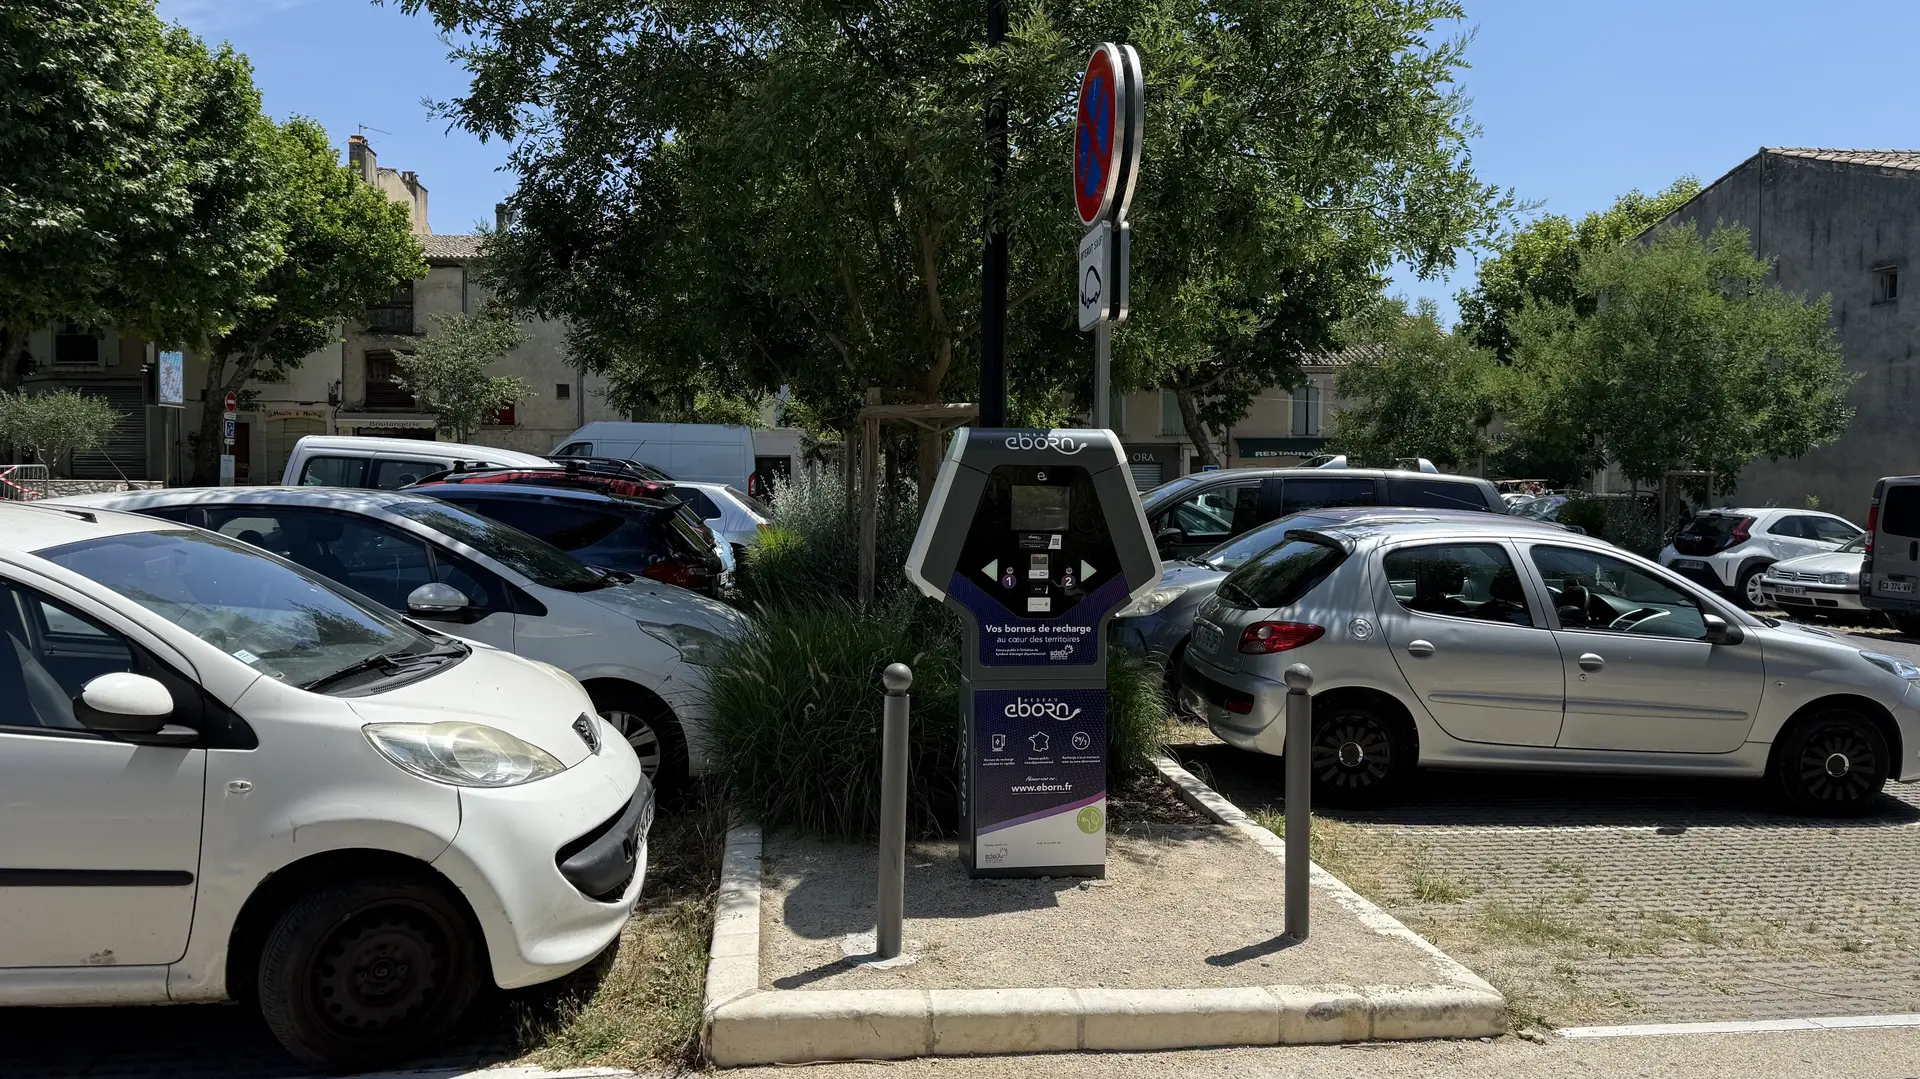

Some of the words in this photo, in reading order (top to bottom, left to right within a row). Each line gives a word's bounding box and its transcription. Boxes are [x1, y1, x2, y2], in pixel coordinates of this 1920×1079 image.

[1005, 432, 1088, 455] eborn
[1132, 452, 1155, 462] ORA
[1005, 576, 1013, 586] 1
[1064, 576, 1073, 586] 2
[985, 624, 1002, 633] Vos
[1005, 624, 1036, 633] bornes
[1038, 624, 1050, 633] de
[1052, 624, 1092, 635] recharge
[1029, 635, 1043, 643] des
[1044, 635, 1080, 643] territoires
[1004, 697, 1082, 721] eborn
[1011, 781, 1073, 792] www.eborn.fr
